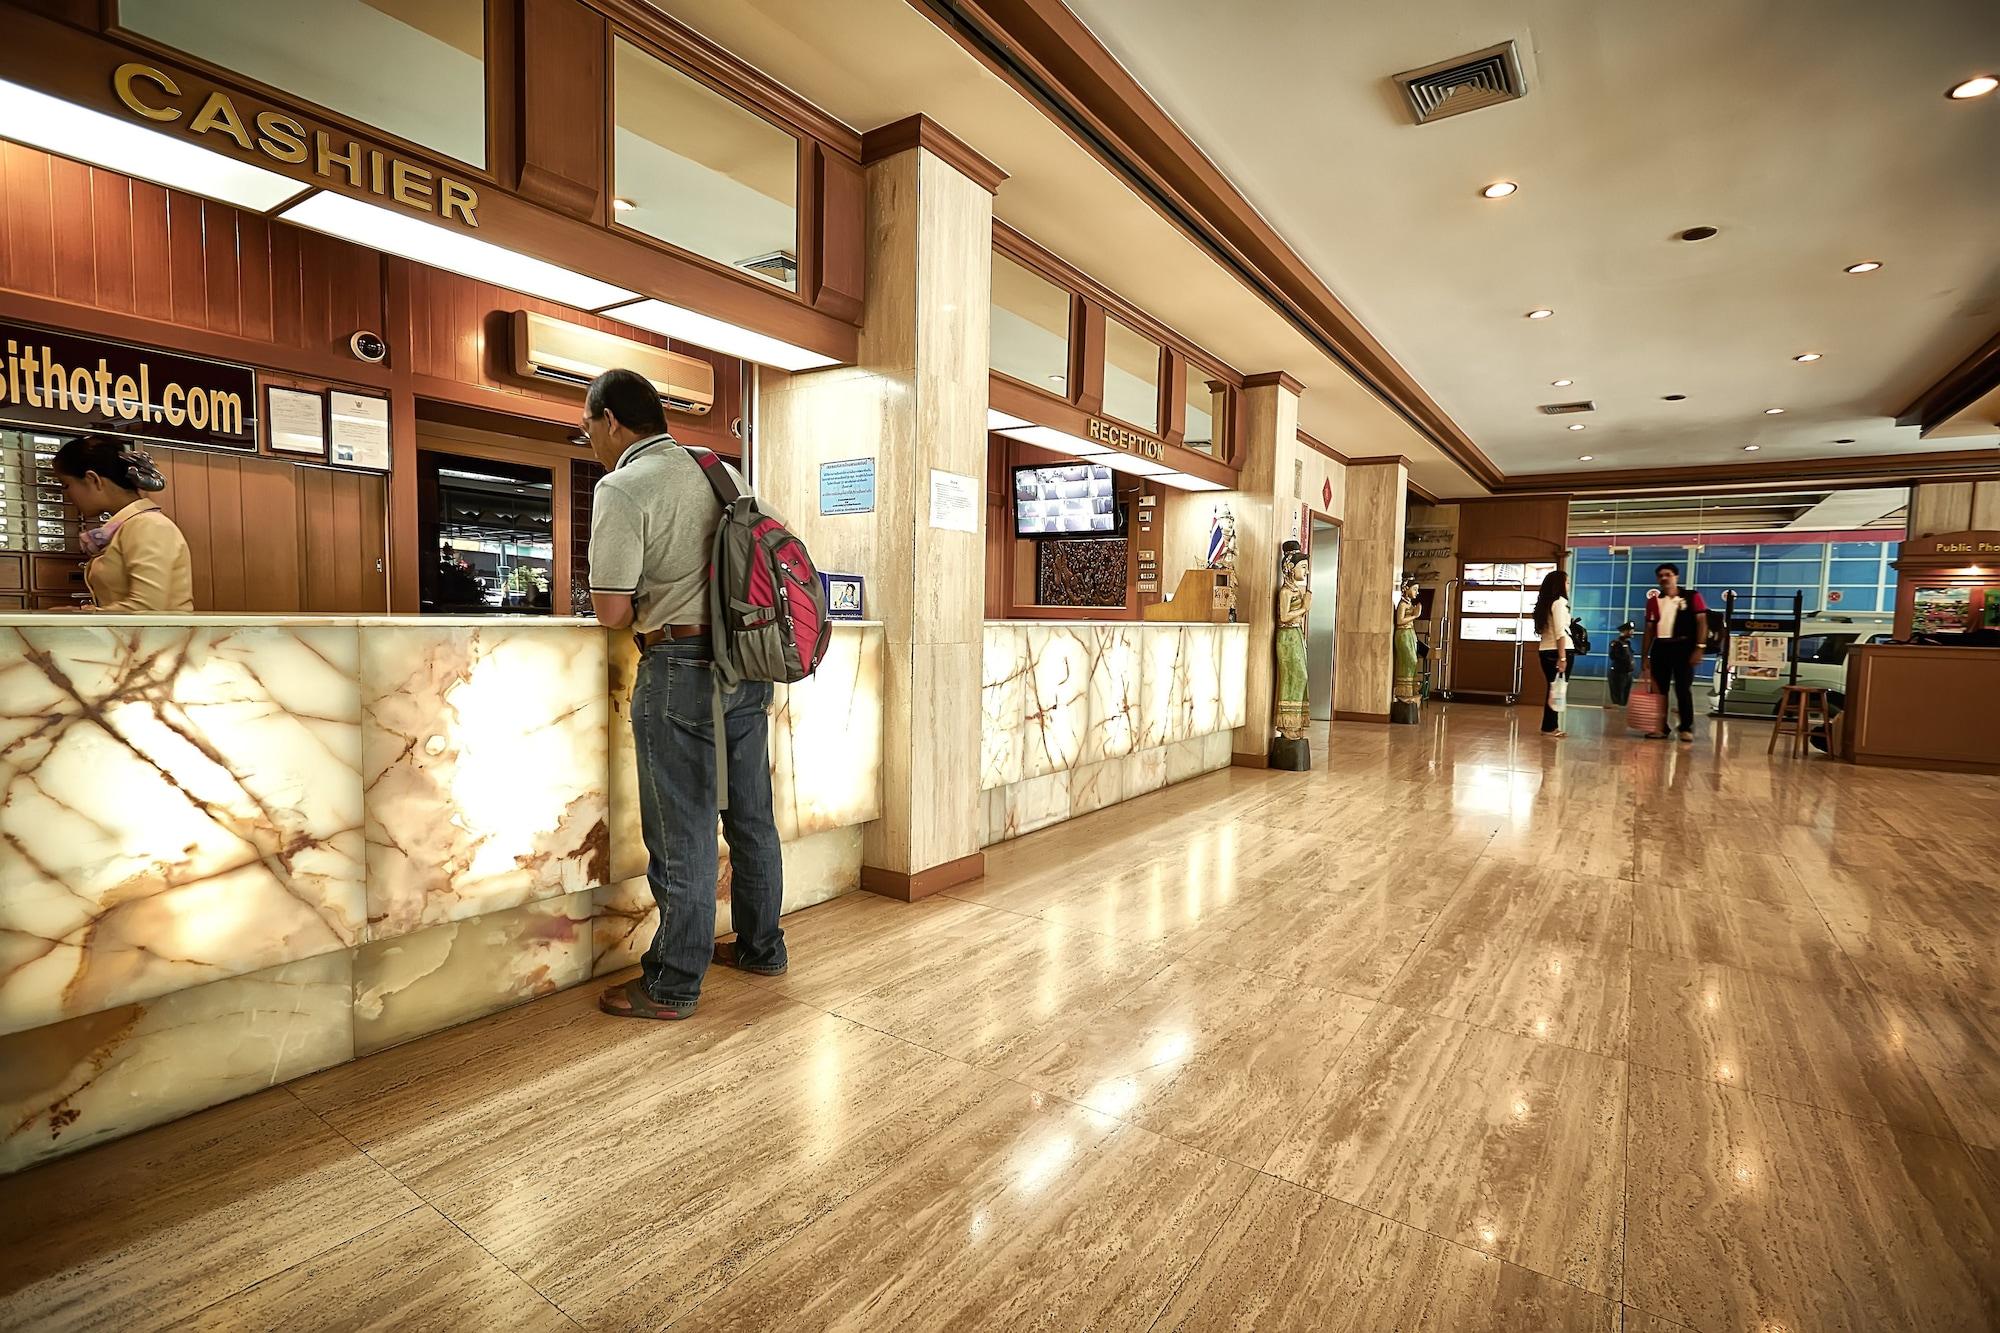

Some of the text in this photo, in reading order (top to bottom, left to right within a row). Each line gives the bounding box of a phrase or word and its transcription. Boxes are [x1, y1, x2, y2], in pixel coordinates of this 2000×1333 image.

[114, 63, 480, 228] CASHIER
[1088, 418, 1165, 461] RECEPTION
[1936, 543, 1972, 552] Public
